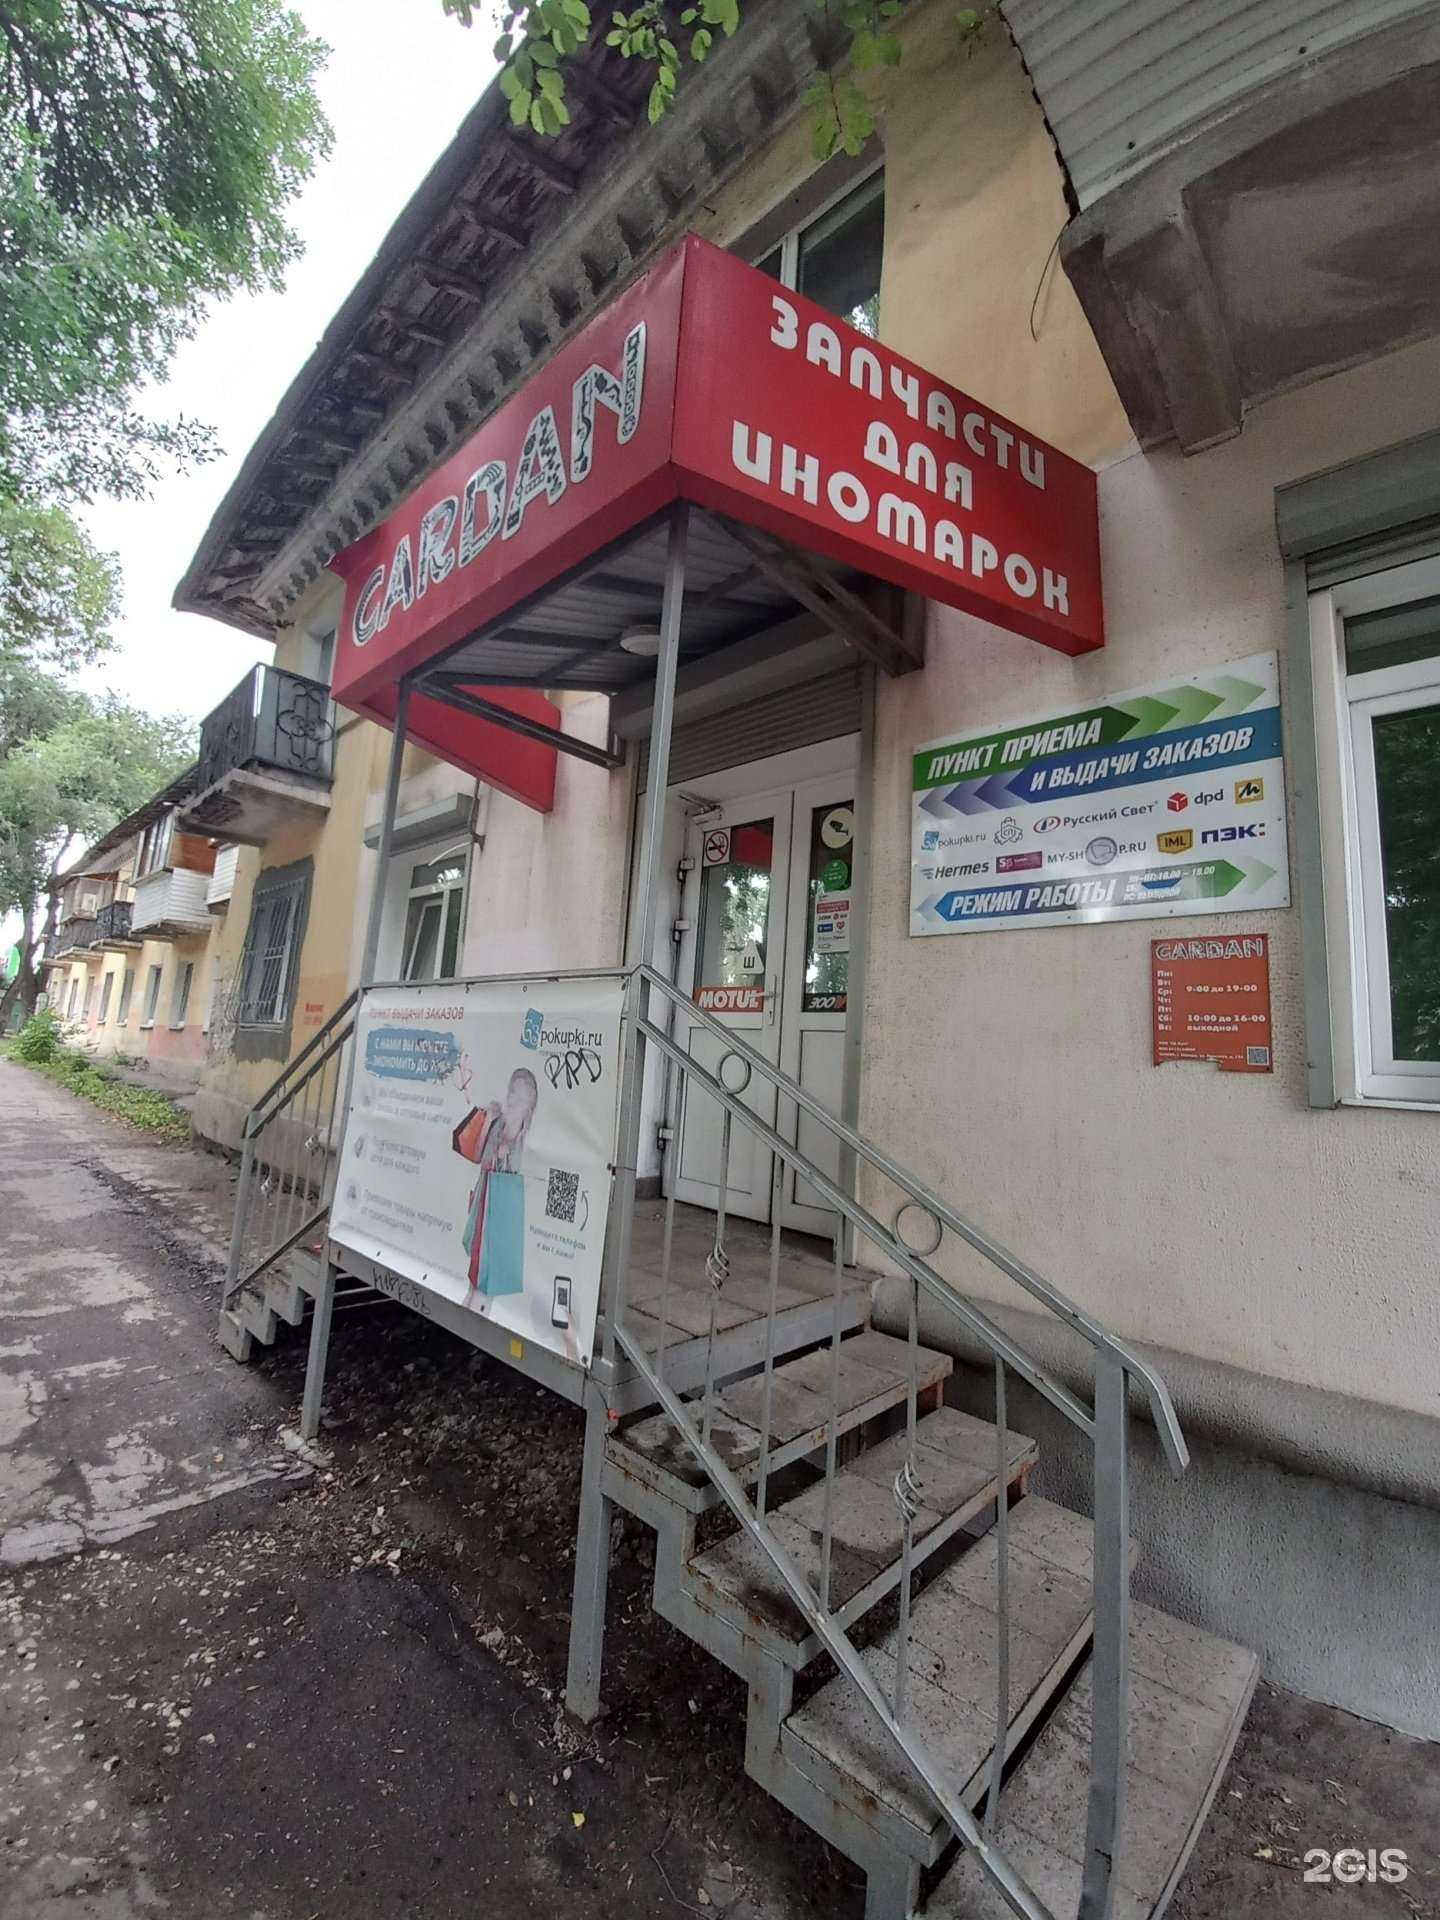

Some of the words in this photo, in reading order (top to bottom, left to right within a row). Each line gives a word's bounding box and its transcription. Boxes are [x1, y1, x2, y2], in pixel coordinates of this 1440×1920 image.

[770, 296, 1045, 490] ЗАПЧАСТИ
[864, 421, 973, 511] ДЛЯ
[352, 320, 646, 647] CARDAN
[732, 420, 1069, 616] ИНОМАРОК
[927, 743, 998, 780] ПУНКТ
[1001, 718, 1102, 764] ПРИЕМА
[1030, 771, 1047, 792] И
[1048, 751, 1139, 789] ВЫДАЧИ
[1142, 727, 1254, 769] ЗАКАЗОВ
[1194, 789, 1224, 806] dpd
[1063, 808, 1117, 828] Русский
[1121, 802, 1154, 817] Свет
[1165, 835, 1187, 848] IML
[934, 861, 989, 880] Hermes
[950, 890, 1022, 915] РЕЖИМ
[1024, 880, 1117, 909] РАБОТЫ
[1155, 938, 1263, 960] CARDAN
[424, 1006, 464, 1020] ЗАКАЗОВ
[541, 1027, 602, 1048] pokupki.ru
[1187, 1025, 1238, 1033] выходной
